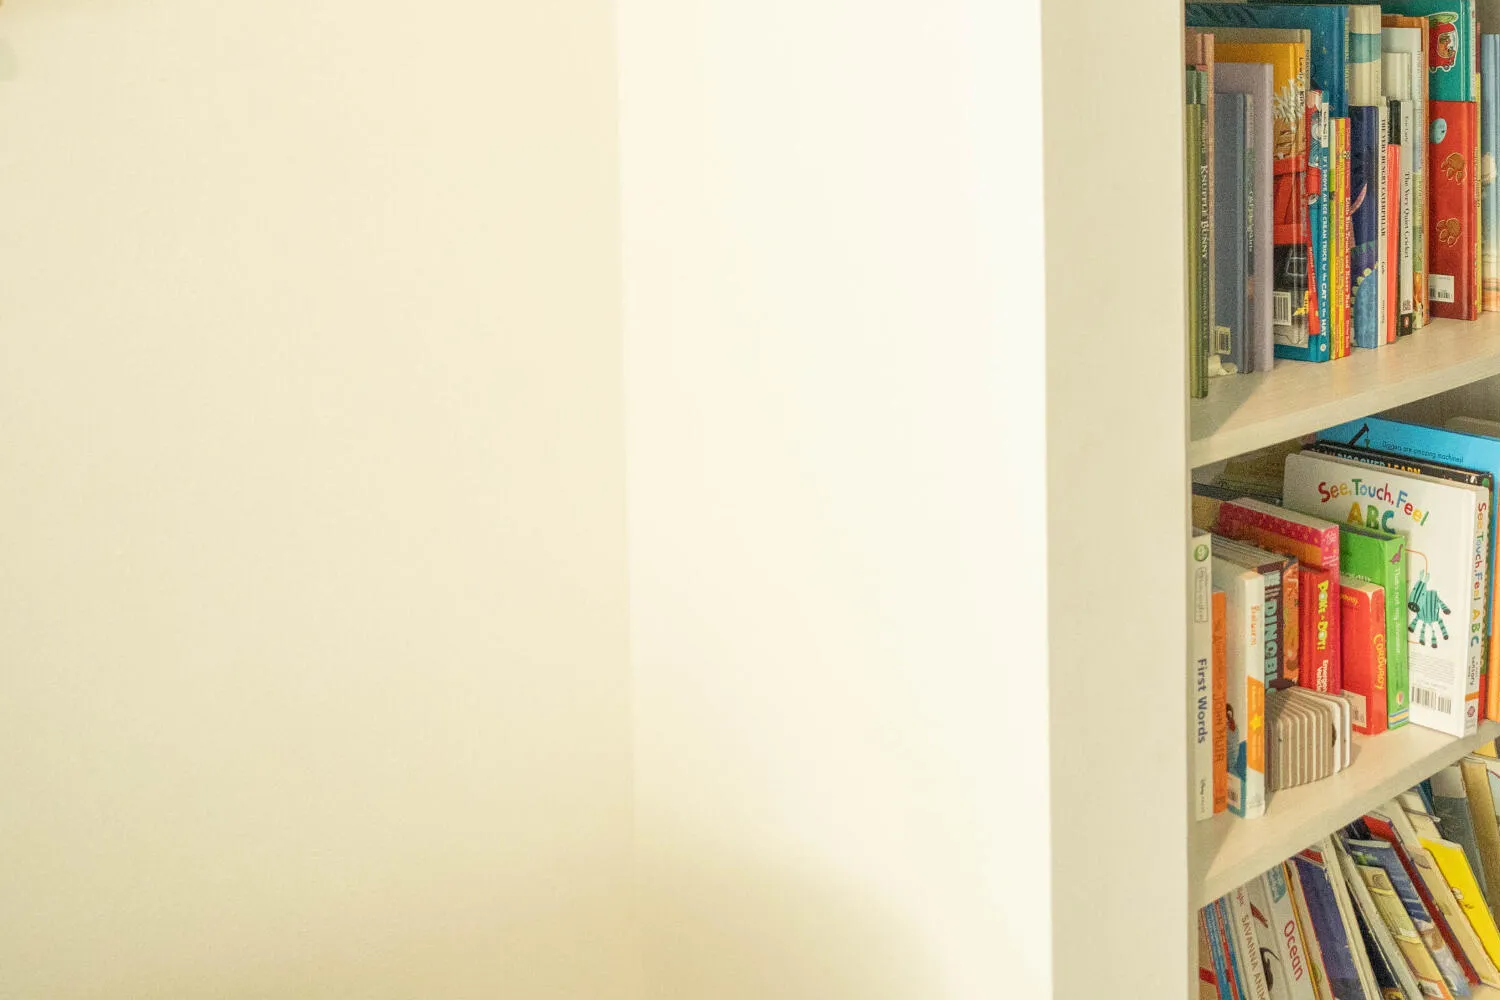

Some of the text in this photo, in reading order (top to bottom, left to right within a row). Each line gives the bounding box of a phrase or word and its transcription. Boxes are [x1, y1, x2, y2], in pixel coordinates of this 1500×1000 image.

[1322, 193, 1328, 203] AN
[1201, 220, 1210, 259] BUNNY
[1413, 448, 1437, 459] amazing
[1346, 501, 1397, 535] ABC
[1351, 478, 1395, 505] Touch,
[1395, 490, 1430, 527] Feel
[1472, 572, 1484, 601] Feel
[1470, 608, 1483, 647] ABC
[1264, 600, 1278, 695] DINOBL
[1197, 658, 1208, 745] First Words
[1241, 914, 1259, 971] SAVANNA
[1284, 920, 1304, 982] Ocean
